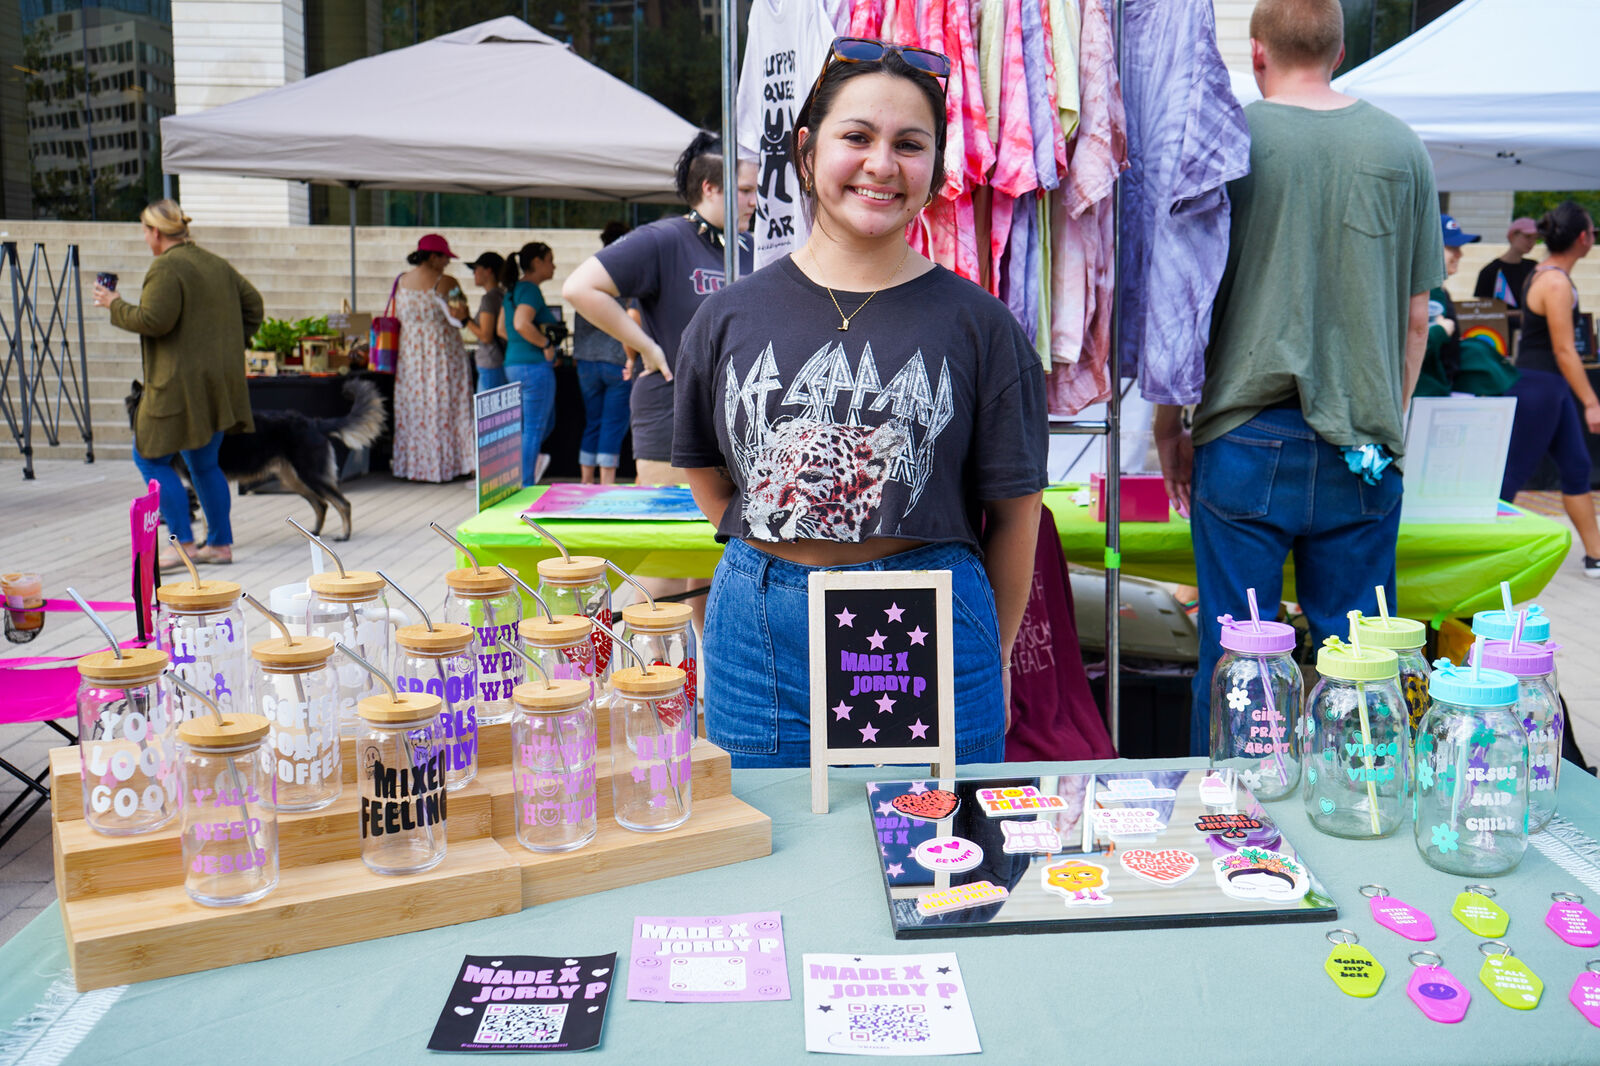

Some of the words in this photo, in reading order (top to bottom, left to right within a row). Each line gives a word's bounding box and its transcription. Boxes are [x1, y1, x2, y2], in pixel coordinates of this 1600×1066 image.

[767, 215, 795, 240] AR
[724, 341, 783, 450] DEF
[781, 340, 955, 452] LEPPARD
[841, 650, 893, 672] MADE
[895, 652, 909, 672] X
[1010, 645, 1055, 675] HEALT
[850, 675, 910, 697] JORDY
[913, 676, 927, 698] P
[100, 710, 167, 742] YOU
[1250, 726, 1287, 738] PRAY
[1244, 742, 1290, 754] ABOUT
[1345, 742, 1398, 757] VIRGO
[1260, 759, 1275, 769] IT
[1465, 765, 1518, 781] JESUS
[1347, 767, 1395, 782] VIBES
[192, 785, 259, 808] Y'ALL
[1470, 791, 1513, 806] SAID
[195, 818, 260, 841] NEED
[1465, 815, 1516, 831] CHILL
[191, 848, 267, 875] JESUS
[951, 849, 975, 864] HAPPY
[640, 923, 725, 940] MADE
[728, 922, 750, 938] X
[654, 938, 754, 957] JORDY
[758, 937, 781, 954] P
[1333, 958, 1373, 967] doing
[462, 964, 555, 985] MADE
[557, 966, 582, 984] X
[809, 963, 899, 981] MADE
[902, 964, 925, 980] X
[471, 984, 581, 1003] JORDY
[583, 981, 608, 1000] P
[828, 983, 929, 1000] JORDY
[936, 982, 959, 999] P
